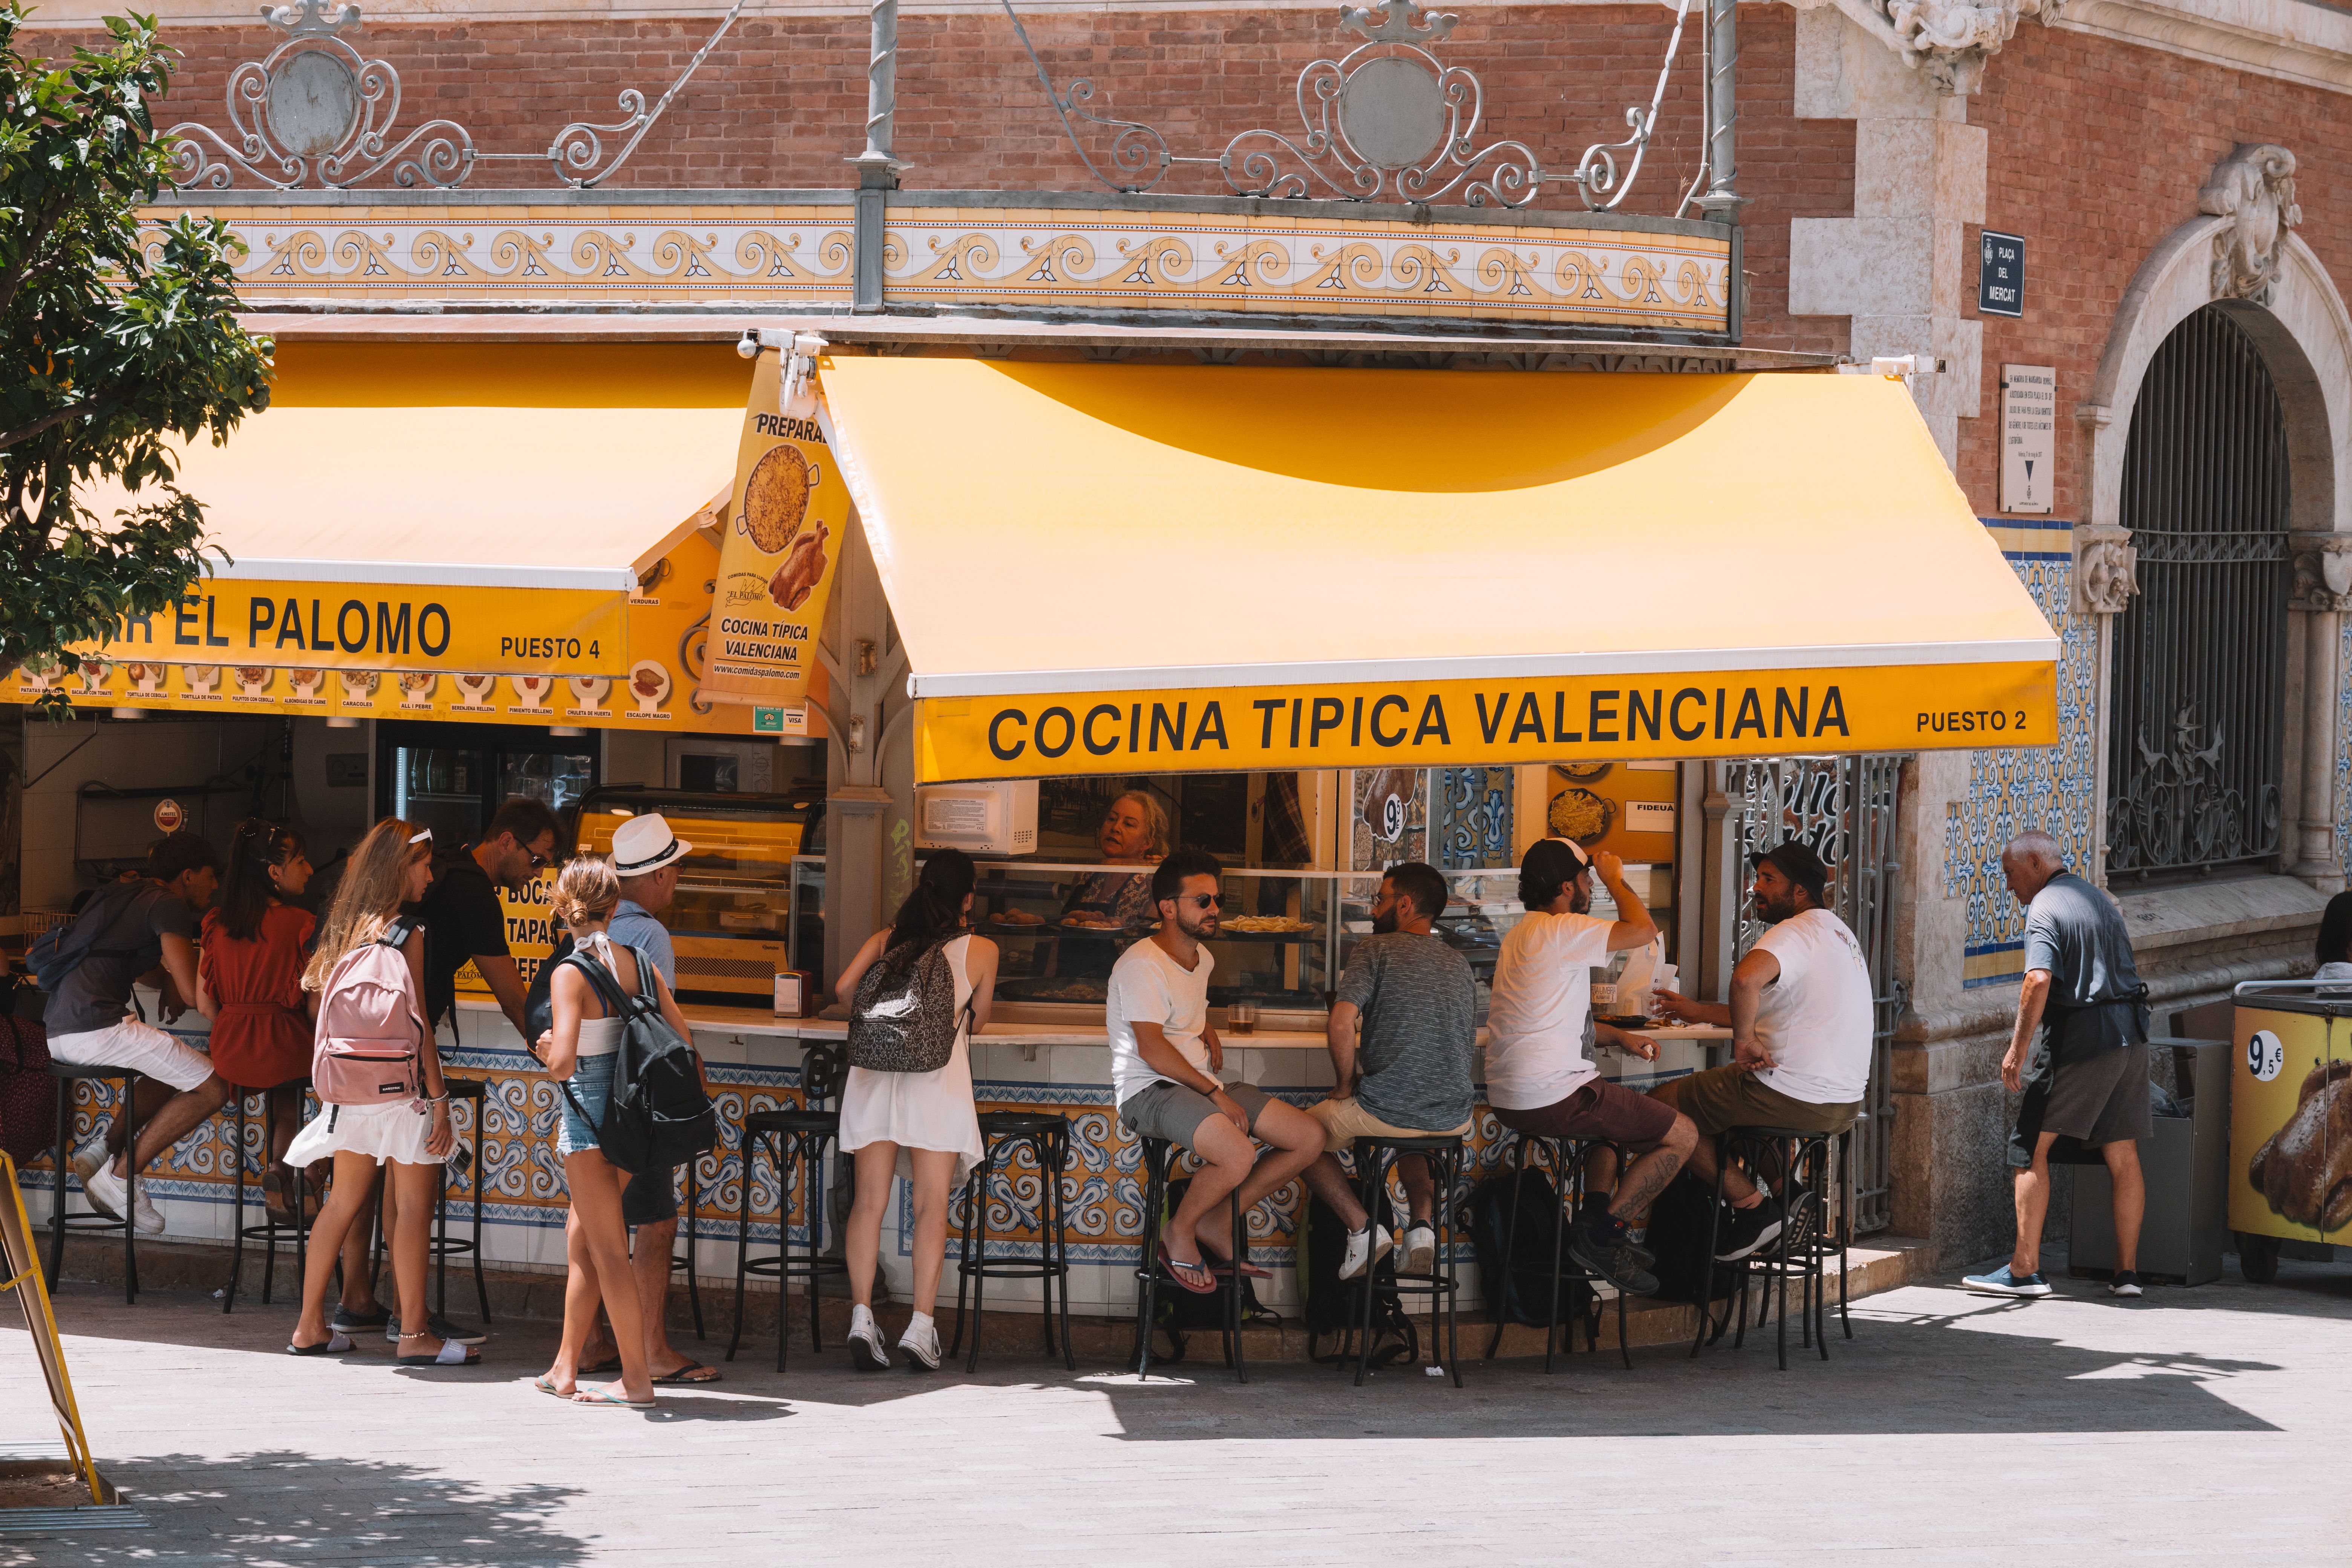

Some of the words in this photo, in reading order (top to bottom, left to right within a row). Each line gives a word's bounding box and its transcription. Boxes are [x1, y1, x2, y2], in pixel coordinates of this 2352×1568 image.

[1999, 247, 2015, 262] PLAÇA
[1998, 267, 2008, 279] DEL
[1989, 286, 2015, 302] MERCAT
[751, 413, 827, 444] PREPARA
[756, 574, 768, 585] LLEVAR
[175, 595, 229, 647] EL
[249, 597, 450, 658] PALOMO
[721, 619, 767, 636] COCINA
[772, 620, 808, 640] TÍPICA
[501, 637, 581, 659] PUESTO
[589, 640, 600, 659] 4
[726, 640, 797, 660] VALENCIANA
[714, 665, 799, 679] www.comidaspalomo.com
[988, 701, 1229, 761] COCINA
[1253, 694, 1452, 749] TIPICA
[1474, 686, 1850, 744] VALENCIANA
[1916, 710, 2006, 733] PUESTO
[2015, 710, 2027, 730] 2
[663, 845, 675, 857] VALENCIA
[638, 859, 657, 868] VALENCIA
[508, 880, 555, 905] BOCA
